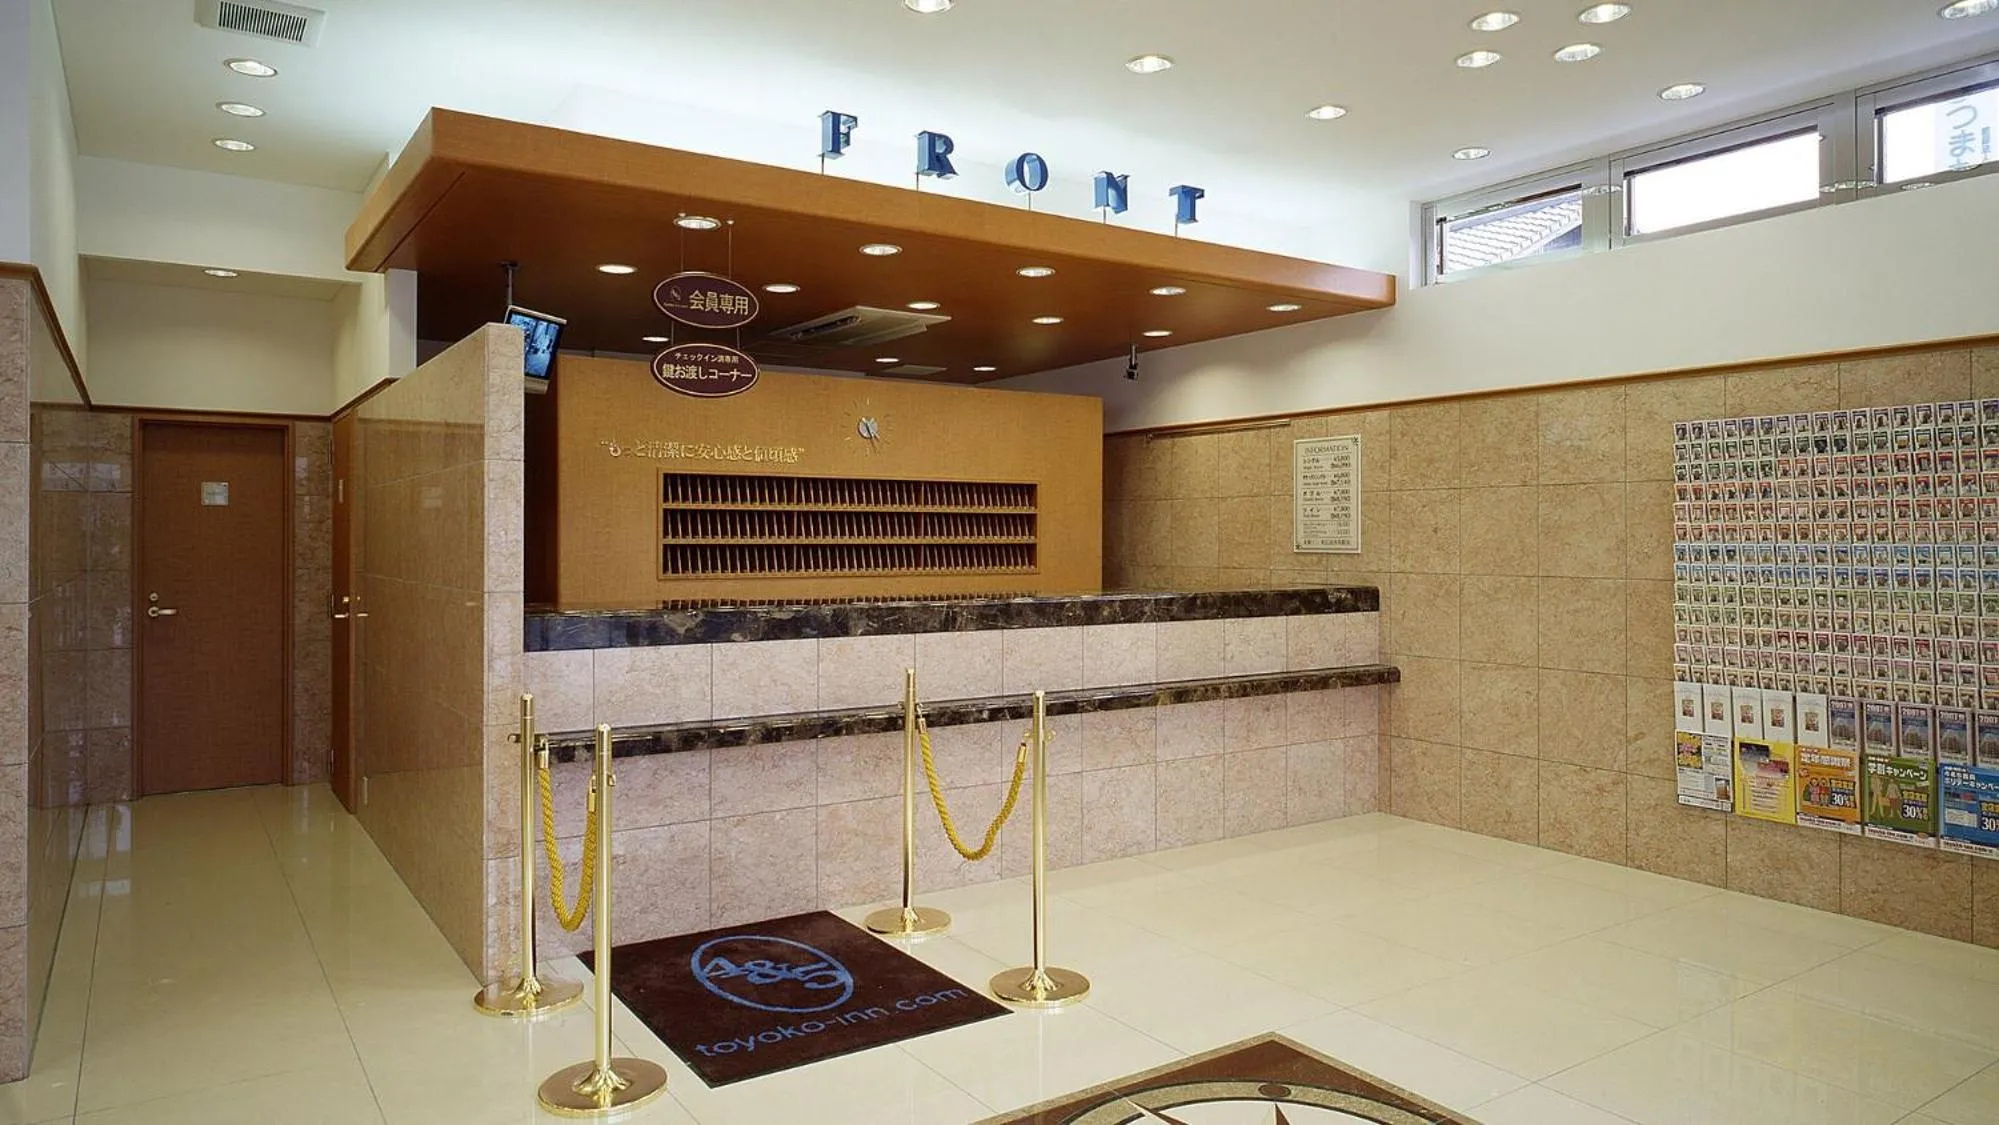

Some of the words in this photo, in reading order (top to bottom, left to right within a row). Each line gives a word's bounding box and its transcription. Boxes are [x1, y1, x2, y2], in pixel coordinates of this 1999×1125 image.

[818, 110, 1205, 224] FRONT
[689, 289, 749, 315] 会員専用
[695, 987, 968, 1057] toyoko-inn.com
